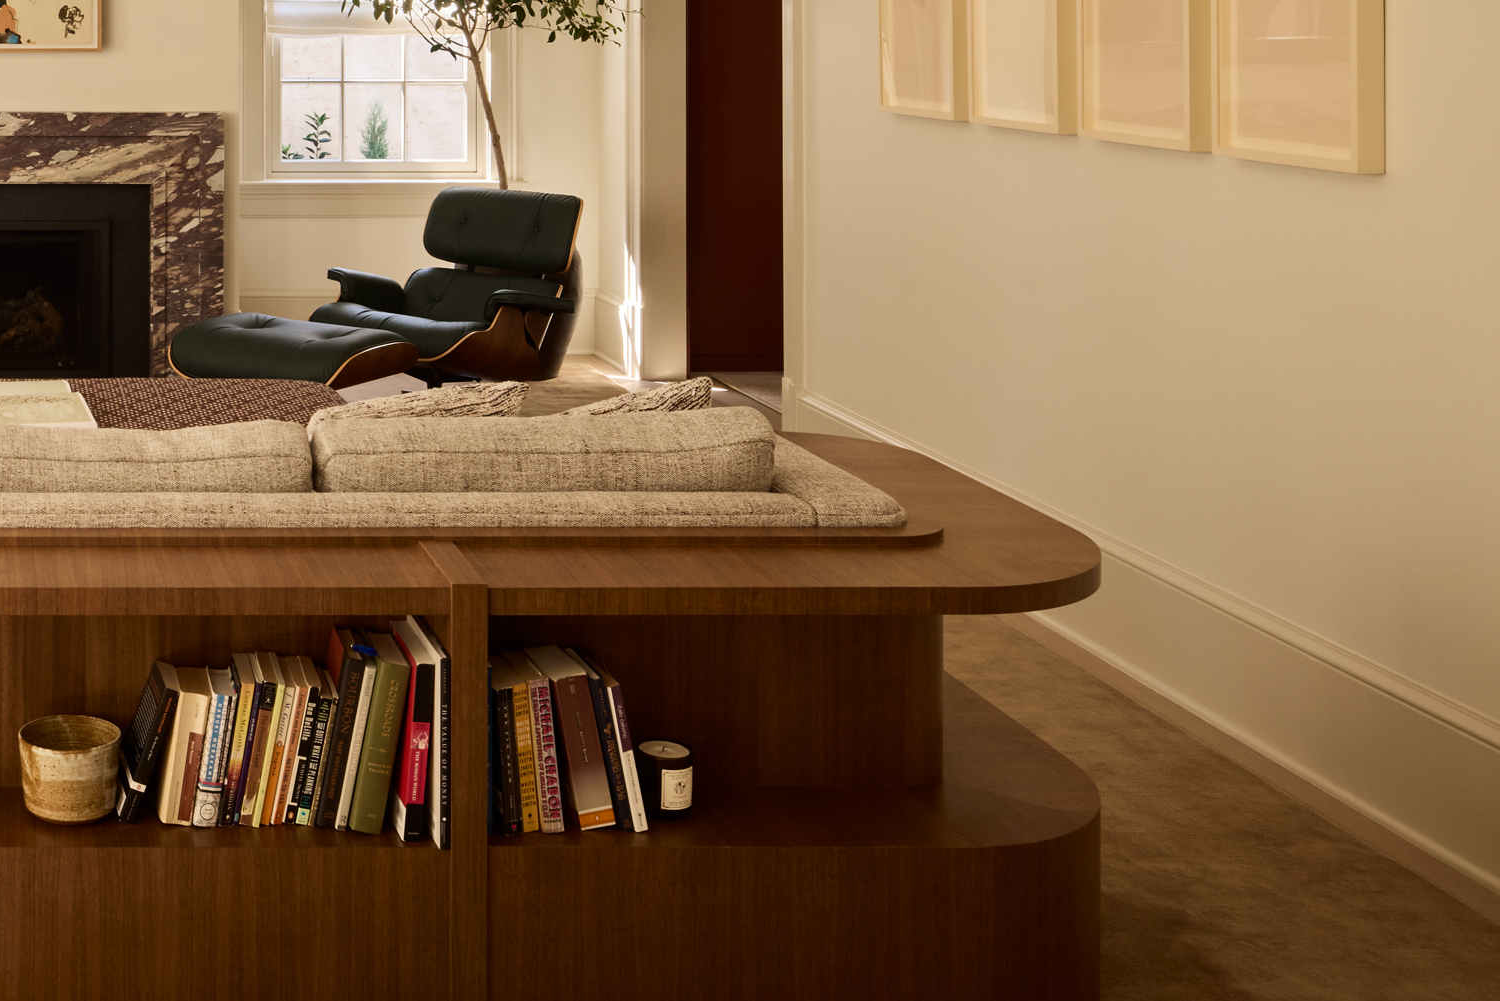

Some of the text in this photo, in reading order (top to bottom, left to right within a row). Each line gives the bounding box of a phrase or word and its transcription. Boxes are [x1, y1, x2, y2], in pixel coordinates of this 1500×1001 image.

[365, 674, 373, 697] Herzfeld
[341, 672, 360, 734] BOURBON
[381, 680, 399, 738] CROSSROADS
[236, 690, 250, 752] Cormac McCarthy
[279, 713, 288, 737] Coetzee
[302, 702, 316, 741] Don DeLillo
[207, 703, 223, 780] HARUKI MURAKAMI
[257, 726, 265, 752] Promised
[314, 730, 324, 744] QUITE
[350, 707, 367, 775] CULTURAL INTIMACY
[272, 752, 280, 776] Disgrace
[311, 745, 321, 759] WHAT
[442, 758, 447, 769] OF
[538, 687, 560, 818] MICHAEL CHABON
[283, 758, 291, 782] GETTING
[328, 756, 342, 800] HUCKELBRIDGE
[539, 762, 544, 770] OF
[607, 740, 626, 801] DRAGONS BAG
[304, 770, 316, 794] PLANNING
